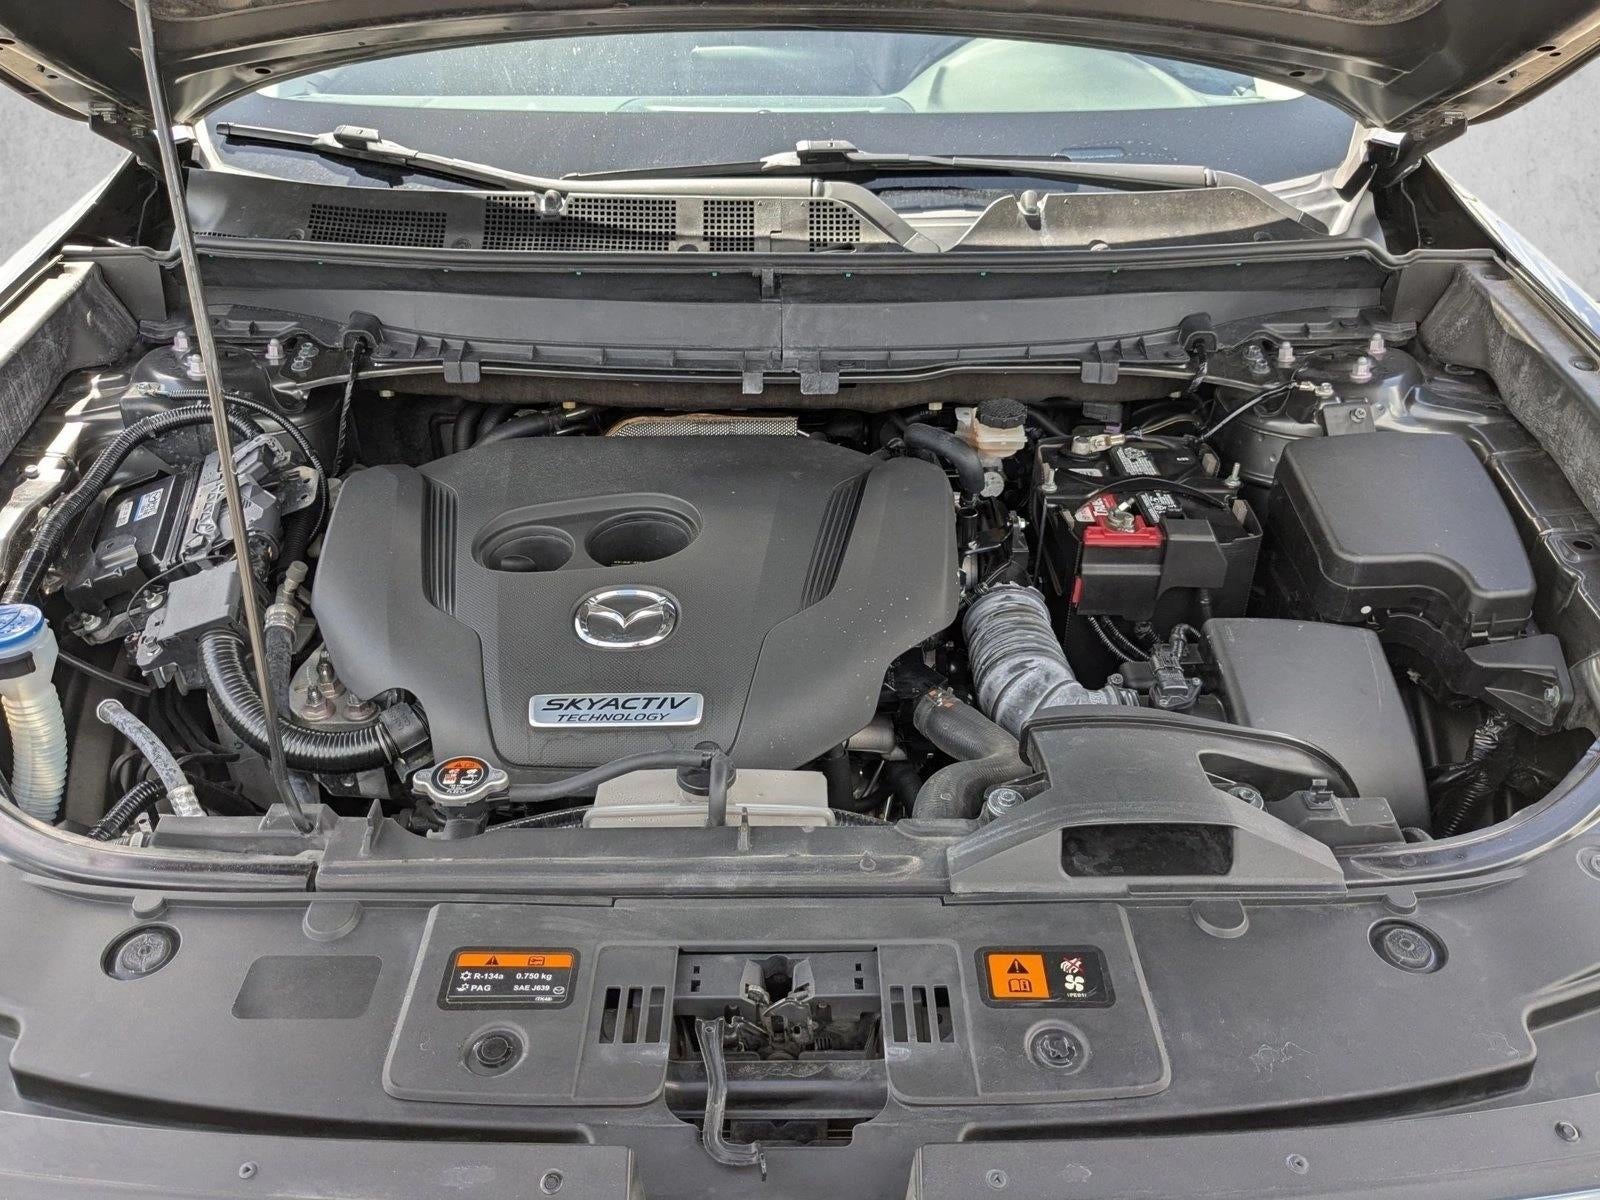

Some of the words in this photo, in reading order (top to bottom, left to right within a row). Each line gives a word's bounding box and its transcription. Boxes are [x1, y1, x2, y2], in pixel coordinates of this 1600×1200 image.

[542, 697, 691, 711] SKYACTIV
[557, 712, 671, 722] TECHNOLOGY
[473, 972, 504, 980] R-134a
[516, 972, 540, 980] 0.750
[541, 972, 553, 981] kg
[470, 984, 492, 992] PAG
